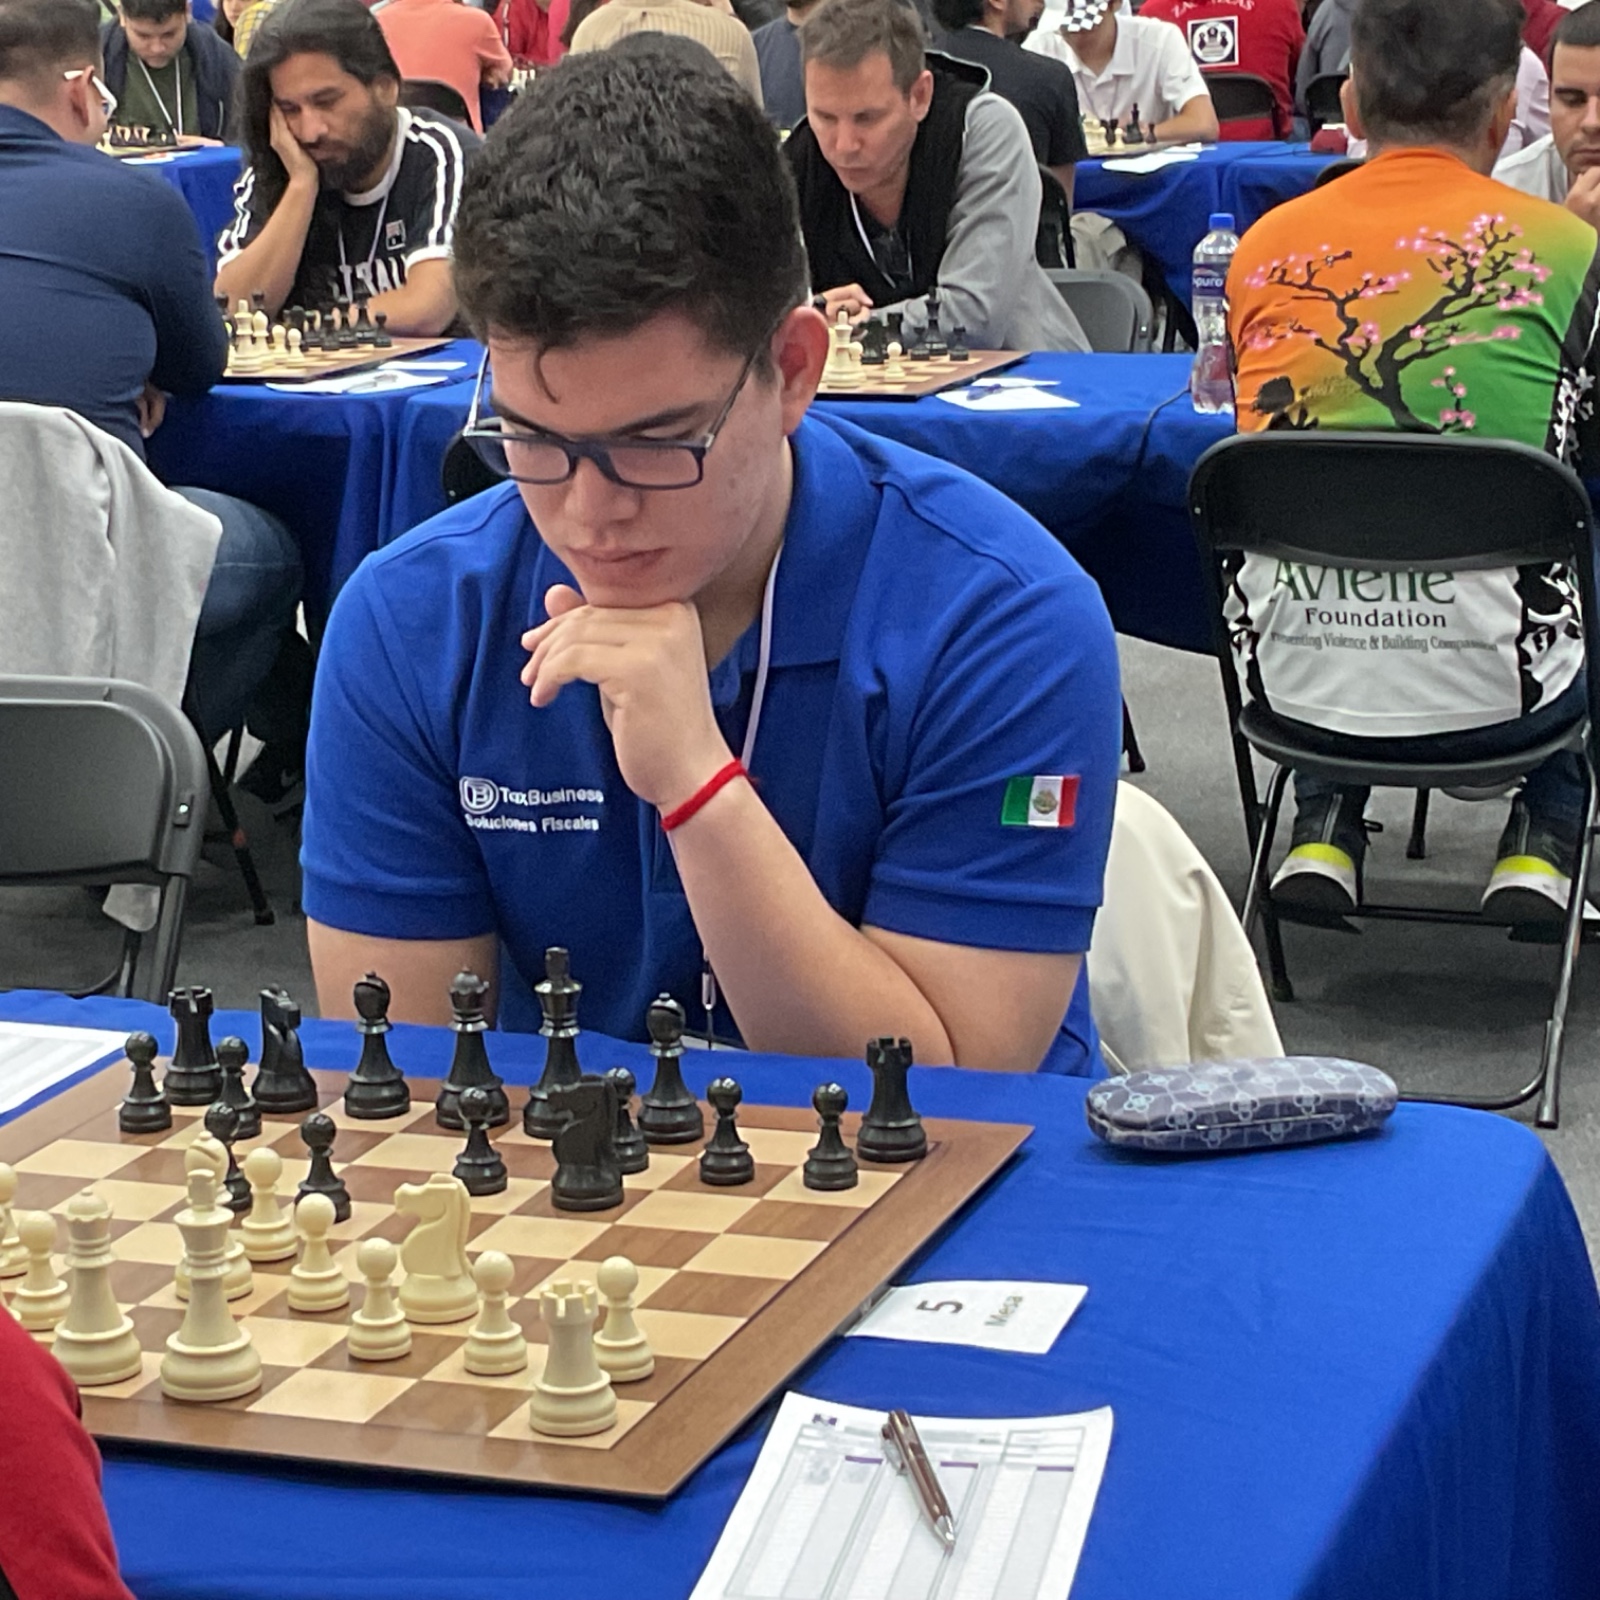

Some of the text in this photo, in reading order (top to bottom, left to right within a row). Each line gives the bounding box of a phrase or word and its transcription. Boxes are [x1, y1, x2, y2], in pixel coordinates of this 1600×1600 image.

[1305, 606, 1447, 628] Foundation
[1323, 633, 1367, 650] Violence
[1369, 634, 1379, 650] &
[1381, 634, 1429, 653] Building
[499, 786, 604, 806] TaxBusiness
[465, 813, 600, 834] Soluciones Fiscales
[916, 1299, 964, 1315] 5
